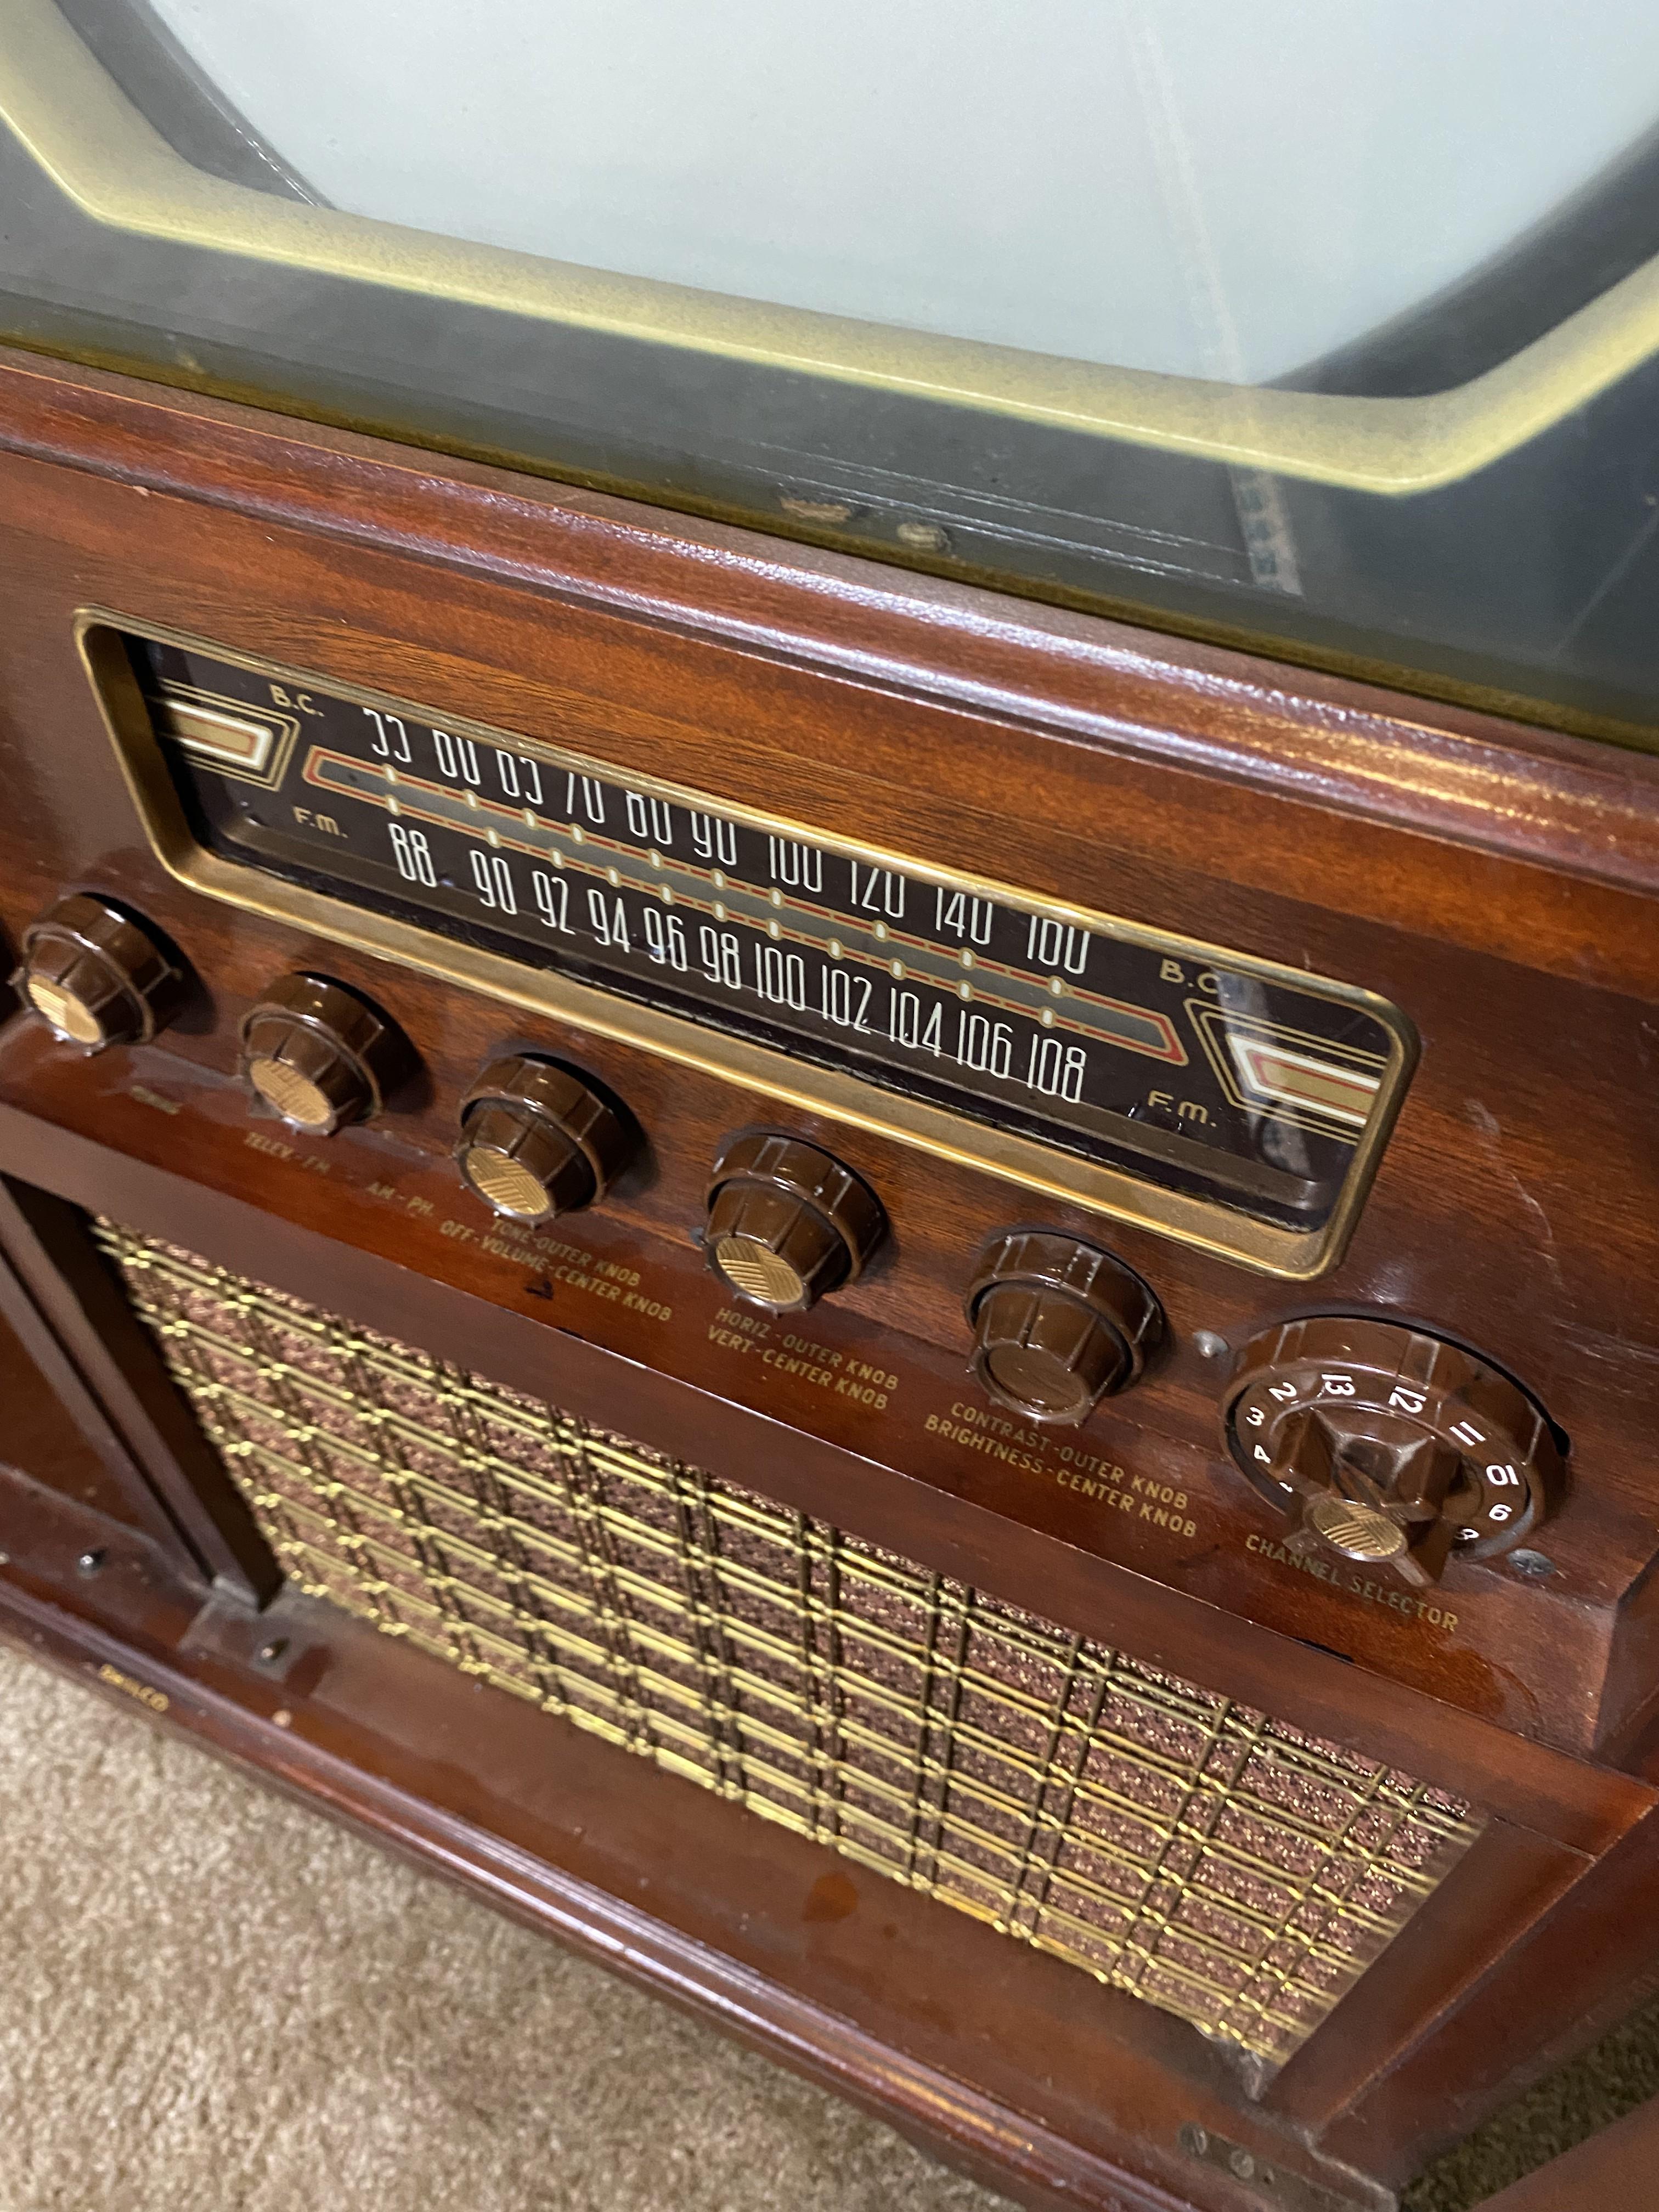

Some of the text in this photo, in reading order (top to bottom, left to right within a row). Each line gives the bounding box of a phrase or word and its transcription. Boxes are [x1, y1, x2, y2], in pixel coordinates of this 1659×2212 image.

[269, 684, 324, 717] B.C.
[388, 822, 1087, 1103] 88 90 92 94 96 98 100 102 104 106 108
[594, 1261, 641, 1286] KNOB
[622, 1291, 672, 1322] KNOB
[846, 1359, 899, 1390] KNOB
[1322, 1373, 1356, 1397] 13
[834, 1378, 888, 1410] KNOB
[1268, 1381, 1297, 1402] 2
[1389, 1386, 1426, 1414] 12
[1246, 1406, 1264, 1426] 3
[1449, 1421, 1486, 1447] 11
[1254, 1444, 1272, 1464] 4
[1131, 1472, 1188, 1510] KNOB
[1139, 1503, 1197, 1537] KNOB
[1245, 1534, 1458, 1632] CHANNEL SELECTOR
